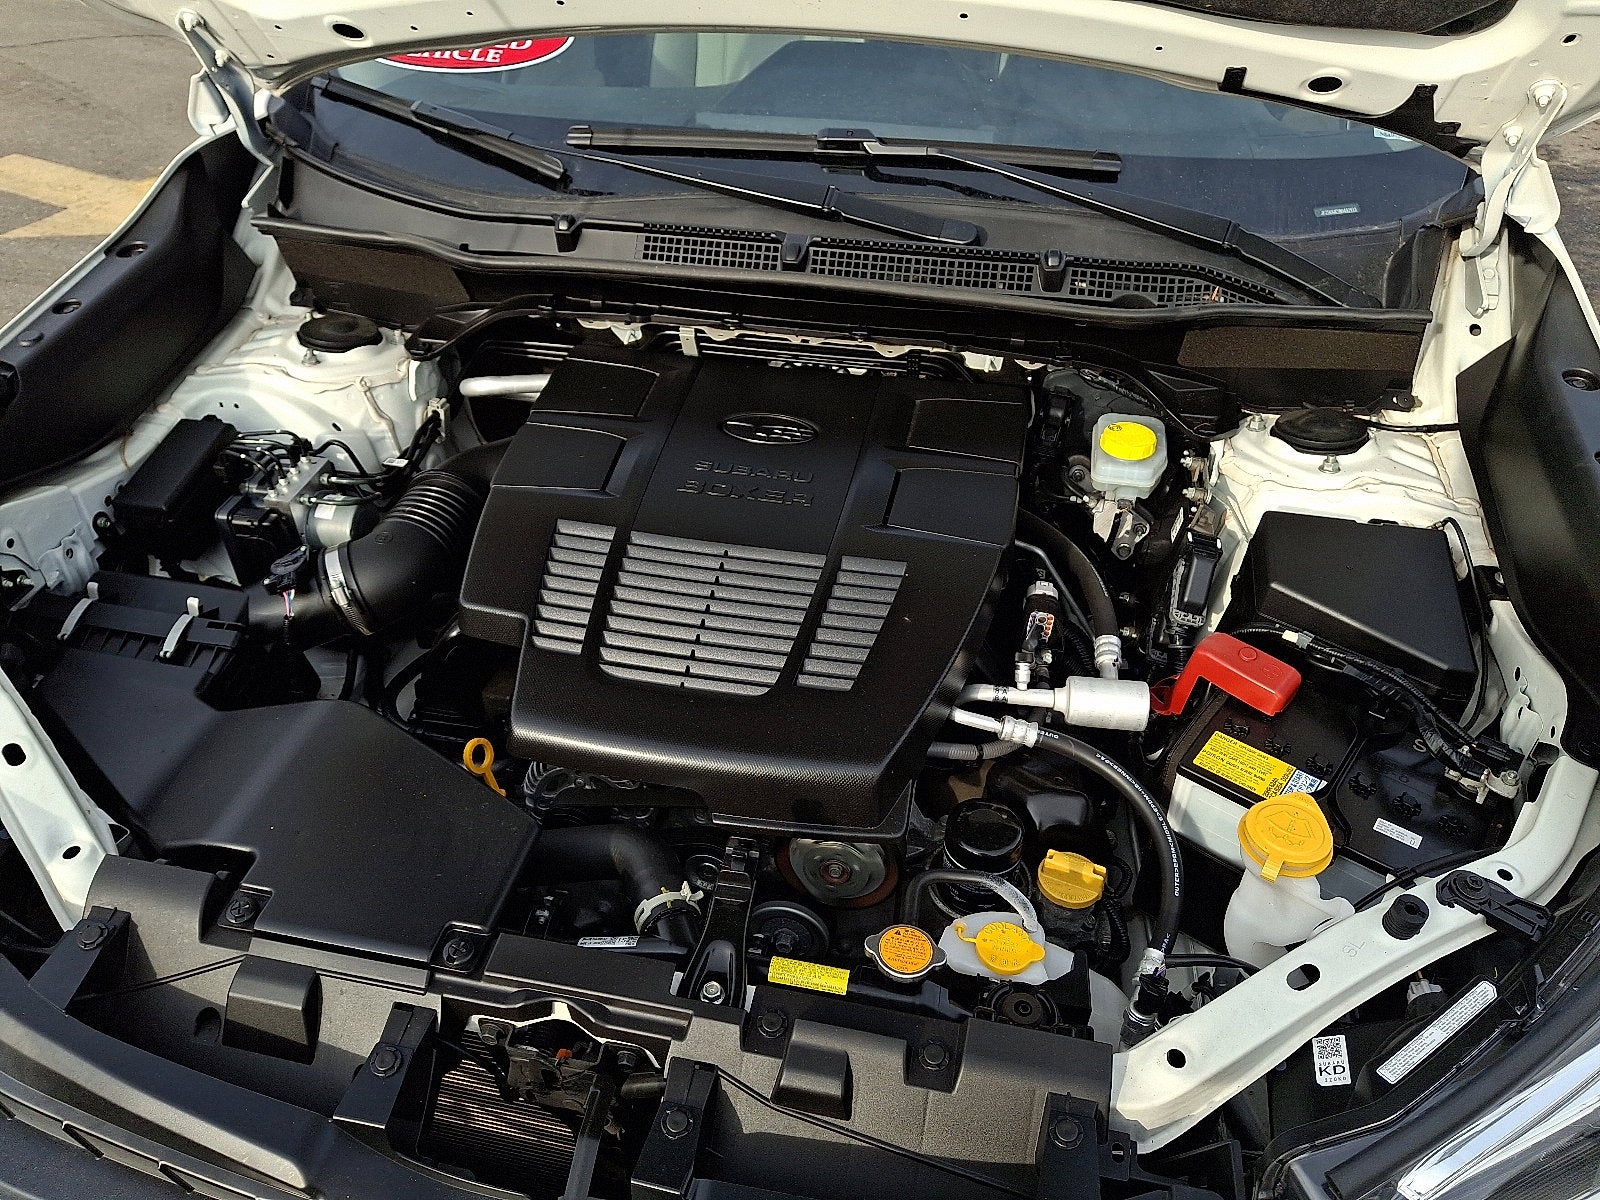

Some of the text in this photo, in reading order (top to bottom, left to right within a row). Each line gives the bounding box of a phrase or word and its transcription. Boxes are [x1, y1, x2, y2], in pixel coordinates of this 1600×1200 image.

[695, 460, 813, 483] SUBARU
[676, 479, 814, 507] BOXER
[1319, 1065, 1346, 1076] KD
